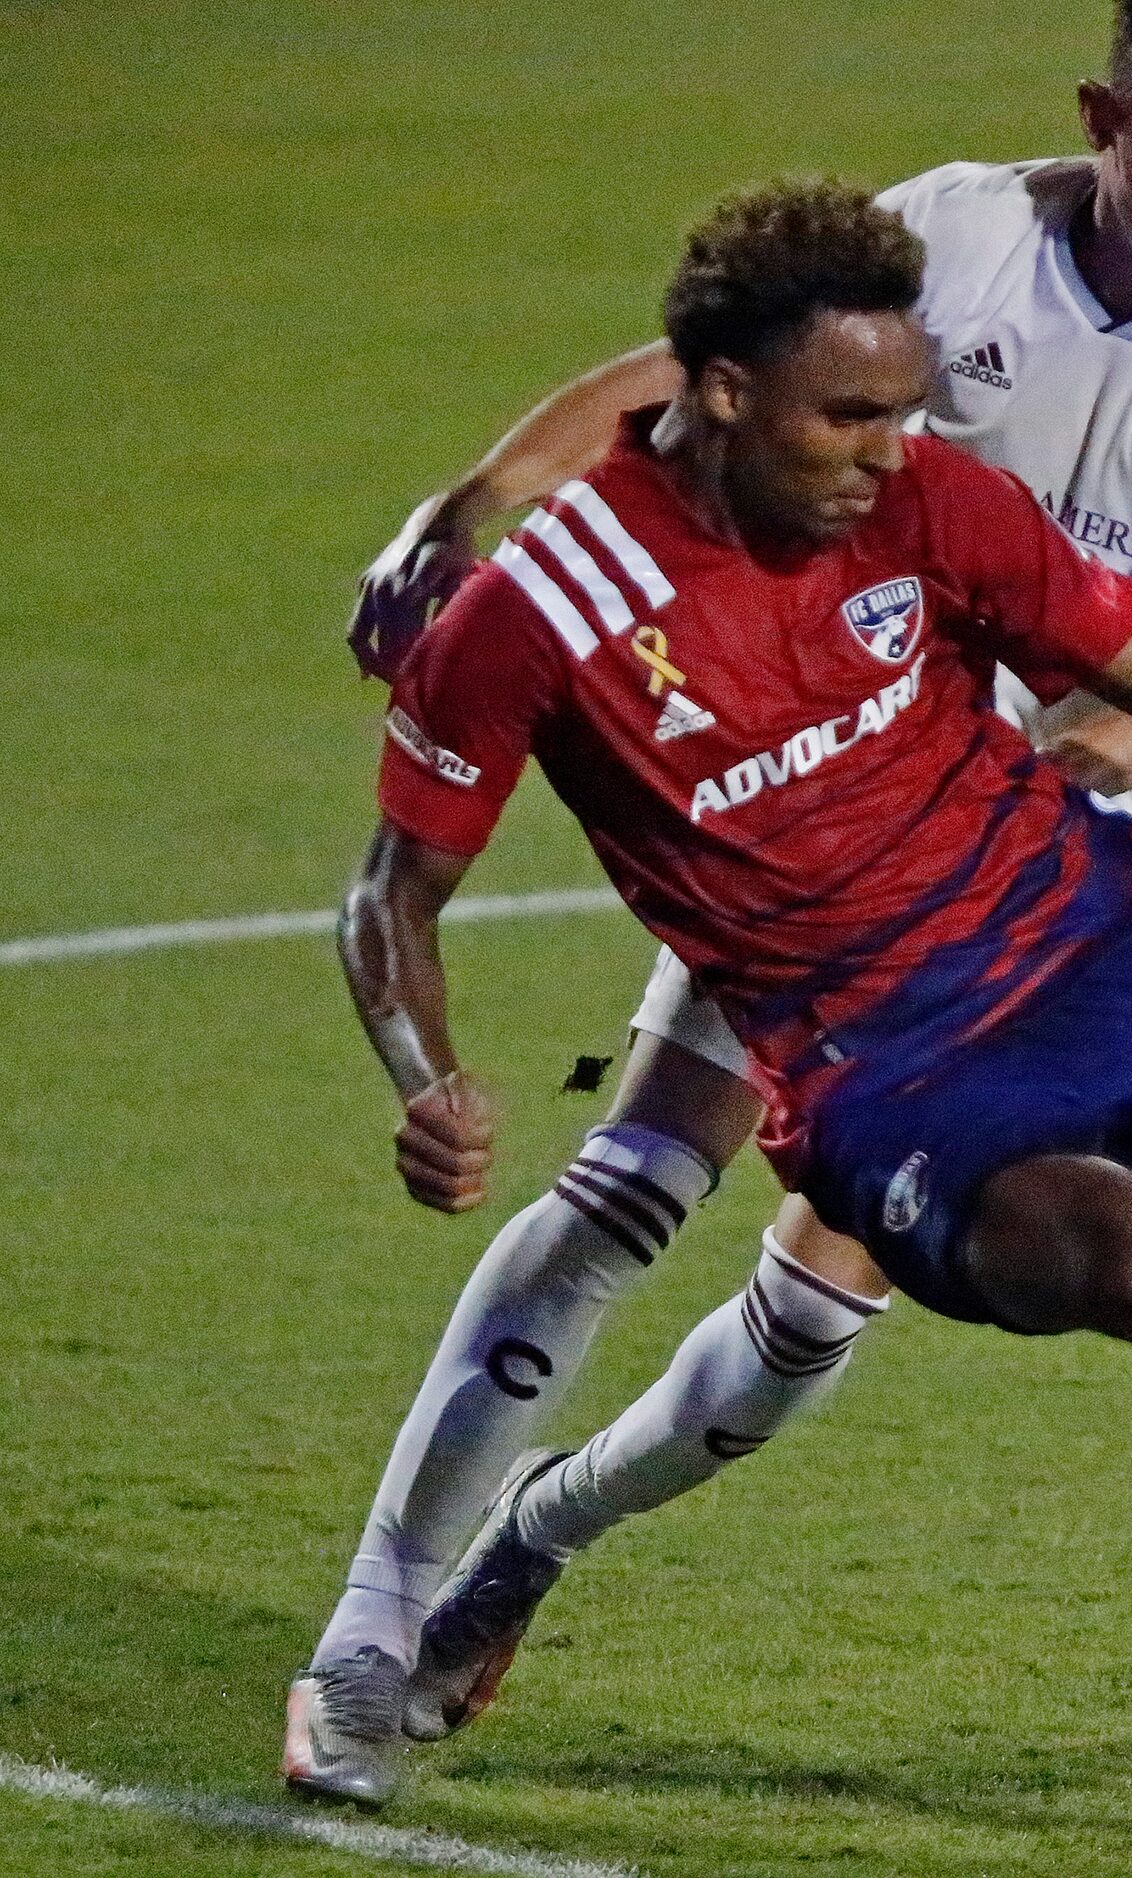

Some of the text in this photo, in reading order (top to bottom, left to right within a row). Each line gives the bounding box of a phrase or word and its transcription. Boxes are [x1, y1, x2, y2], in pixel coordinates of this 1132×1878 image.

[950, 359, 1013, 391] adidas
[850, 582, 917, 623] FC DALLAS
[654, 711, 717, 742] adidas
[485, 1336, 553, 1401] C
